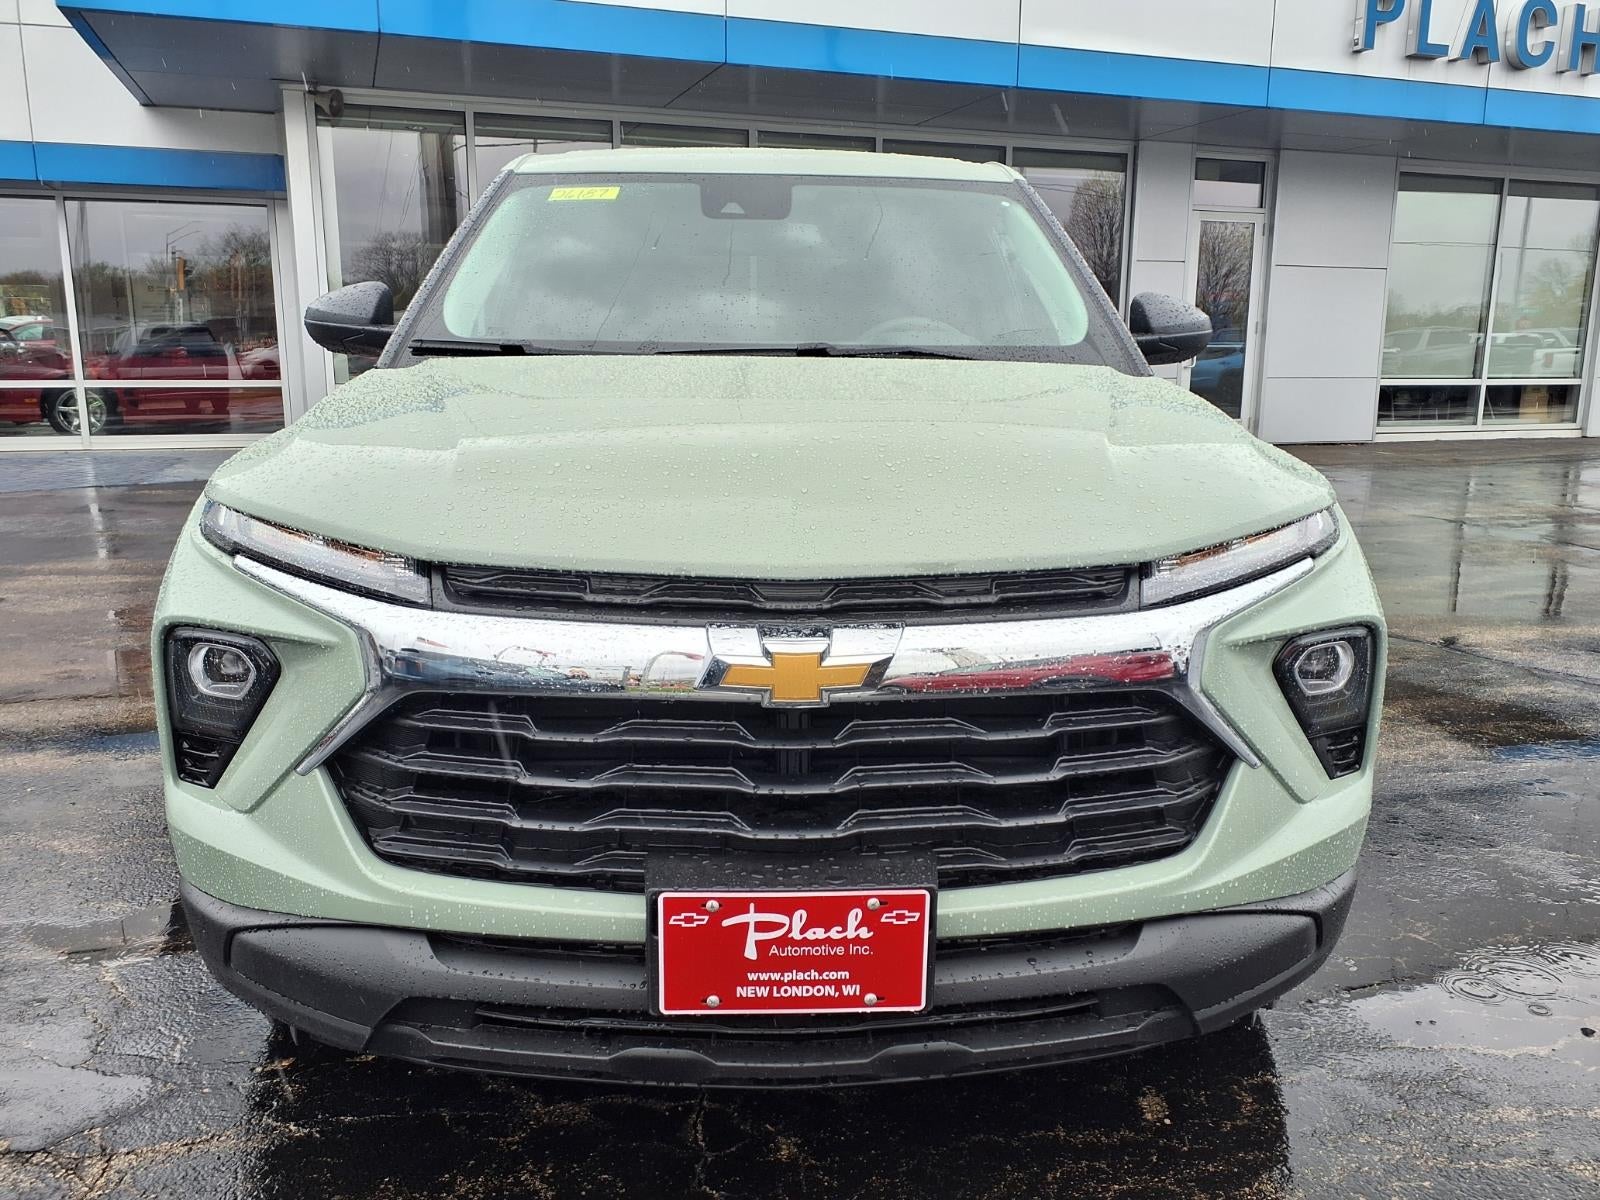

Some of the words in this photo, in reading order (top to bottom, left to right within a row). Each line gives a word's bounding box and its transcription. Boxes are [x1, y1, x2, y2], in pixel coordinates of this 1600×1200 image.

[1353, 0, 1600, 75] PLACH
[722, 903, 873, 960] Plach
[769, 944, 844, 956] Automotive
[848, 943, 874, 956] Inc.
[747, 969, 849, 982] www.plach.com
[736, 985, 770, 998] NEW
[772, 985, 840, 999] LONDON,
[842, 984, 860, 996] WI
